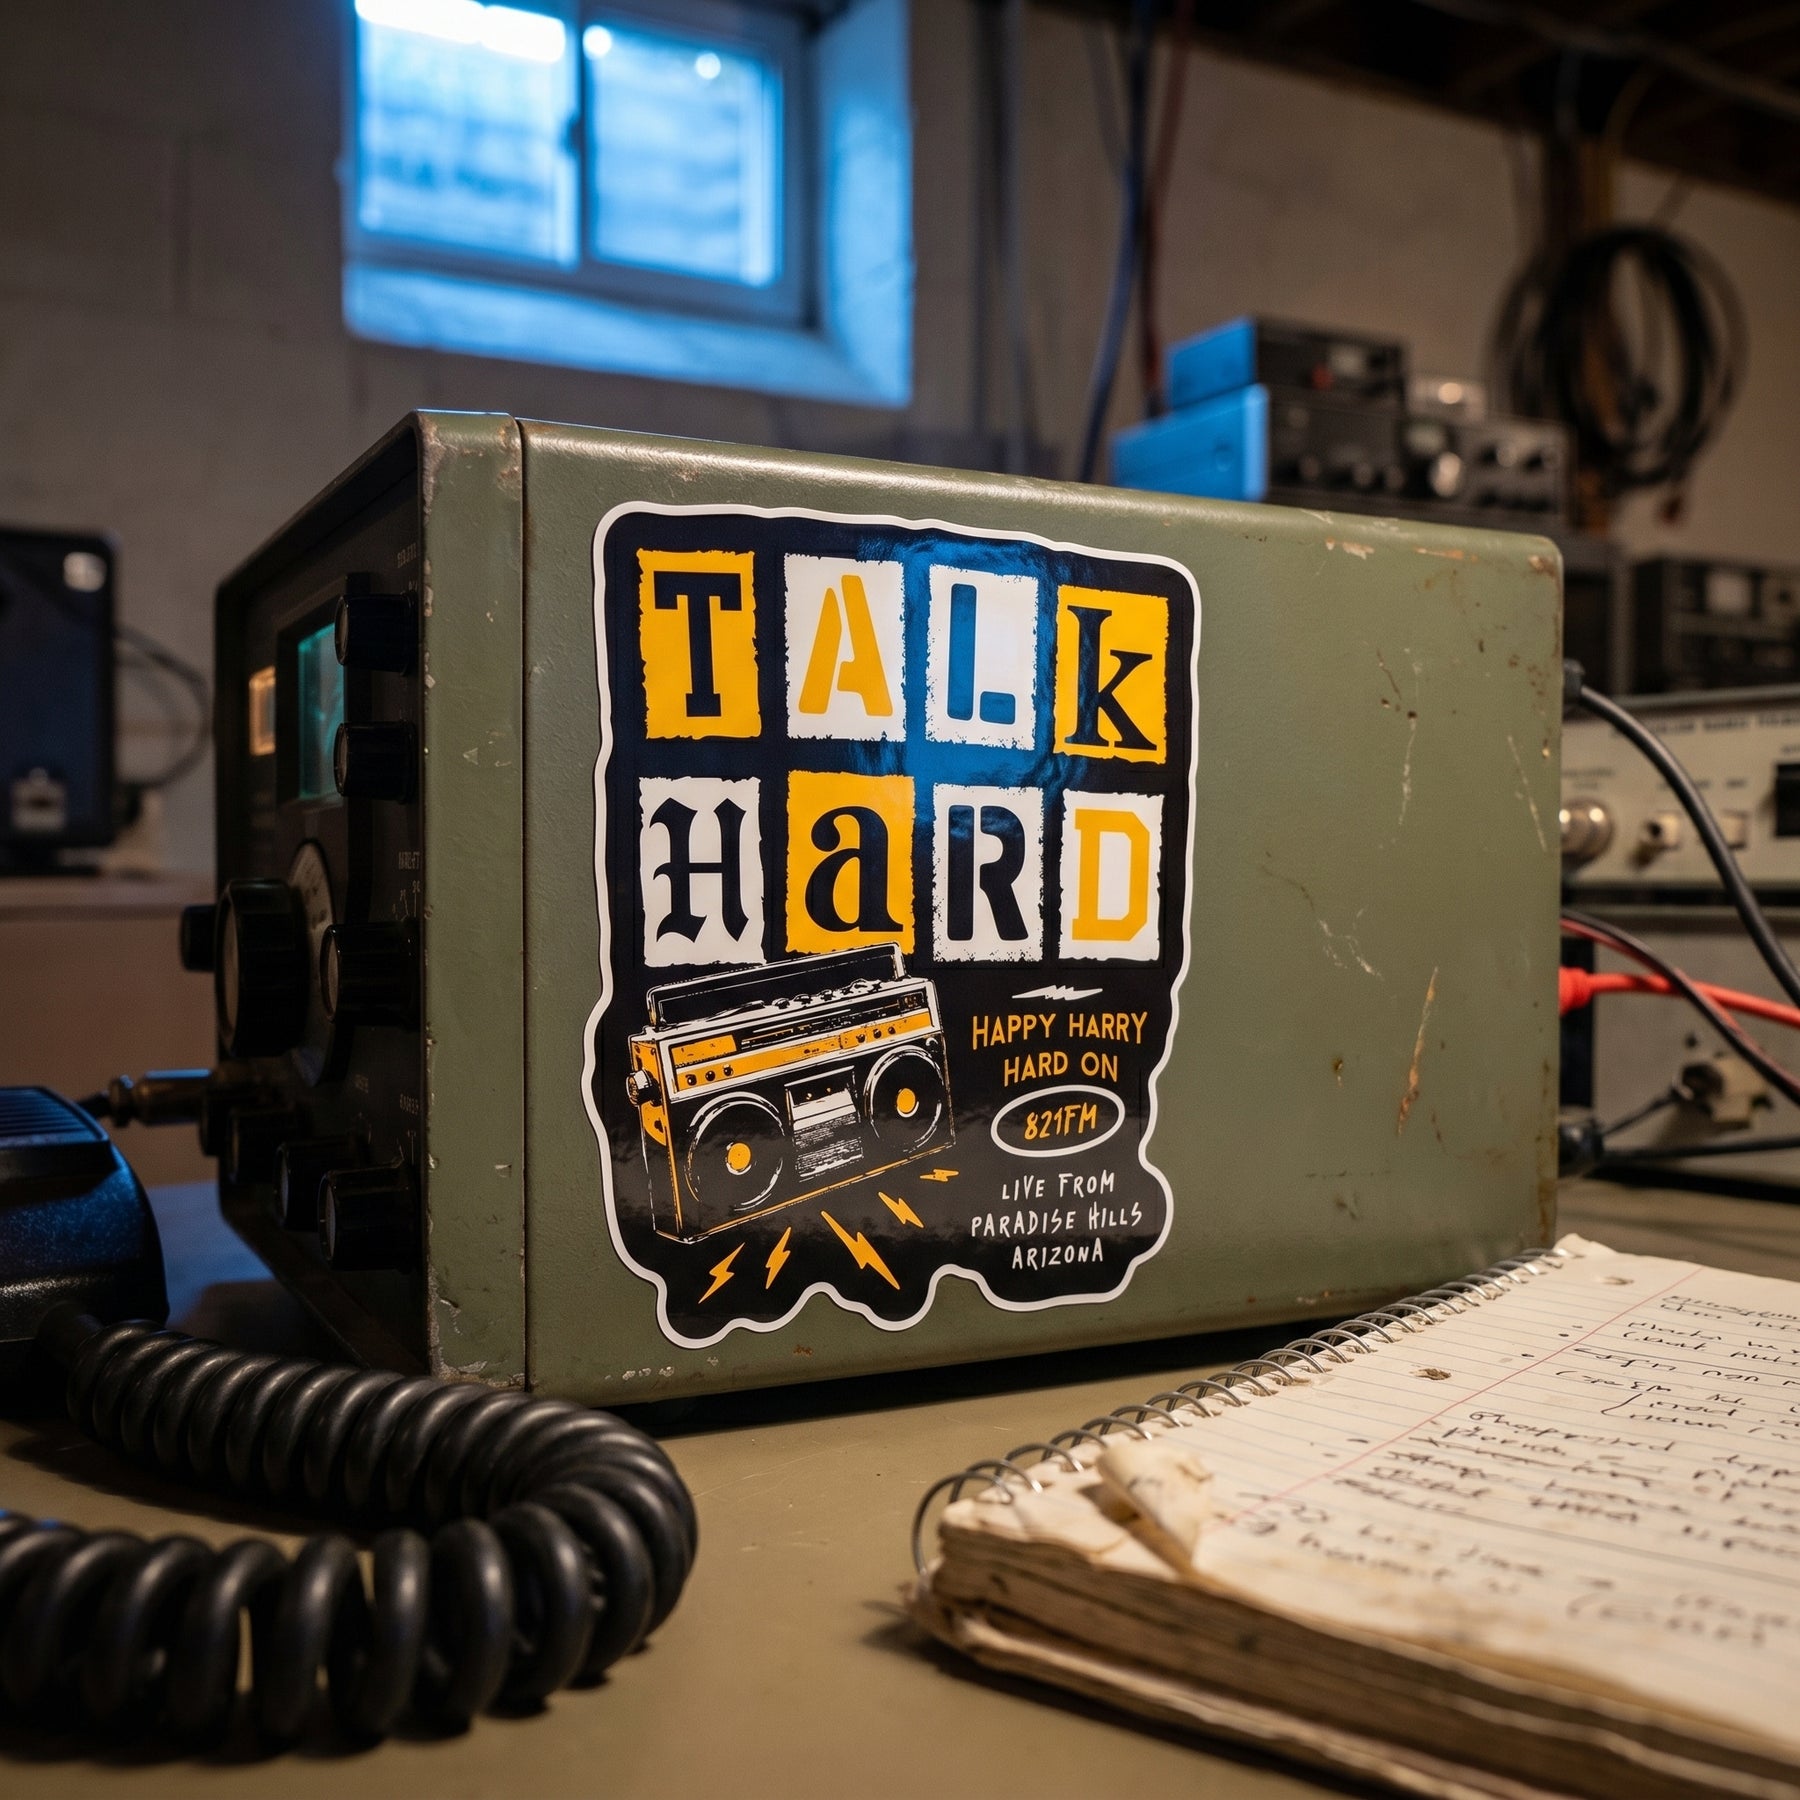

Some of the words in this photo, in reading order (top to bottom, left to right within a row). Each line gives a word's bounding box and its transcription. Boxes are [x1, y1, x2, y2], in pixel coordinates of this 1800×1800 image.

[972, 1013, 1056, 1050] HAPPY
[1068, 1012, 1148, 1044] HARRY
[1004, 1052, 1068, 1087] HARD
[1080, 1051, 1118, 1082] ON
[1002, 1175, 1045, 1200] LIVE
[1058, 1169, 1115, 1198] FROM
[971, 1208, 1076, 1238] PARADISE
[1088, 1201, 1142, 1230] HILLS
[1012, 1237, 1103, 1270] ARIZONA
